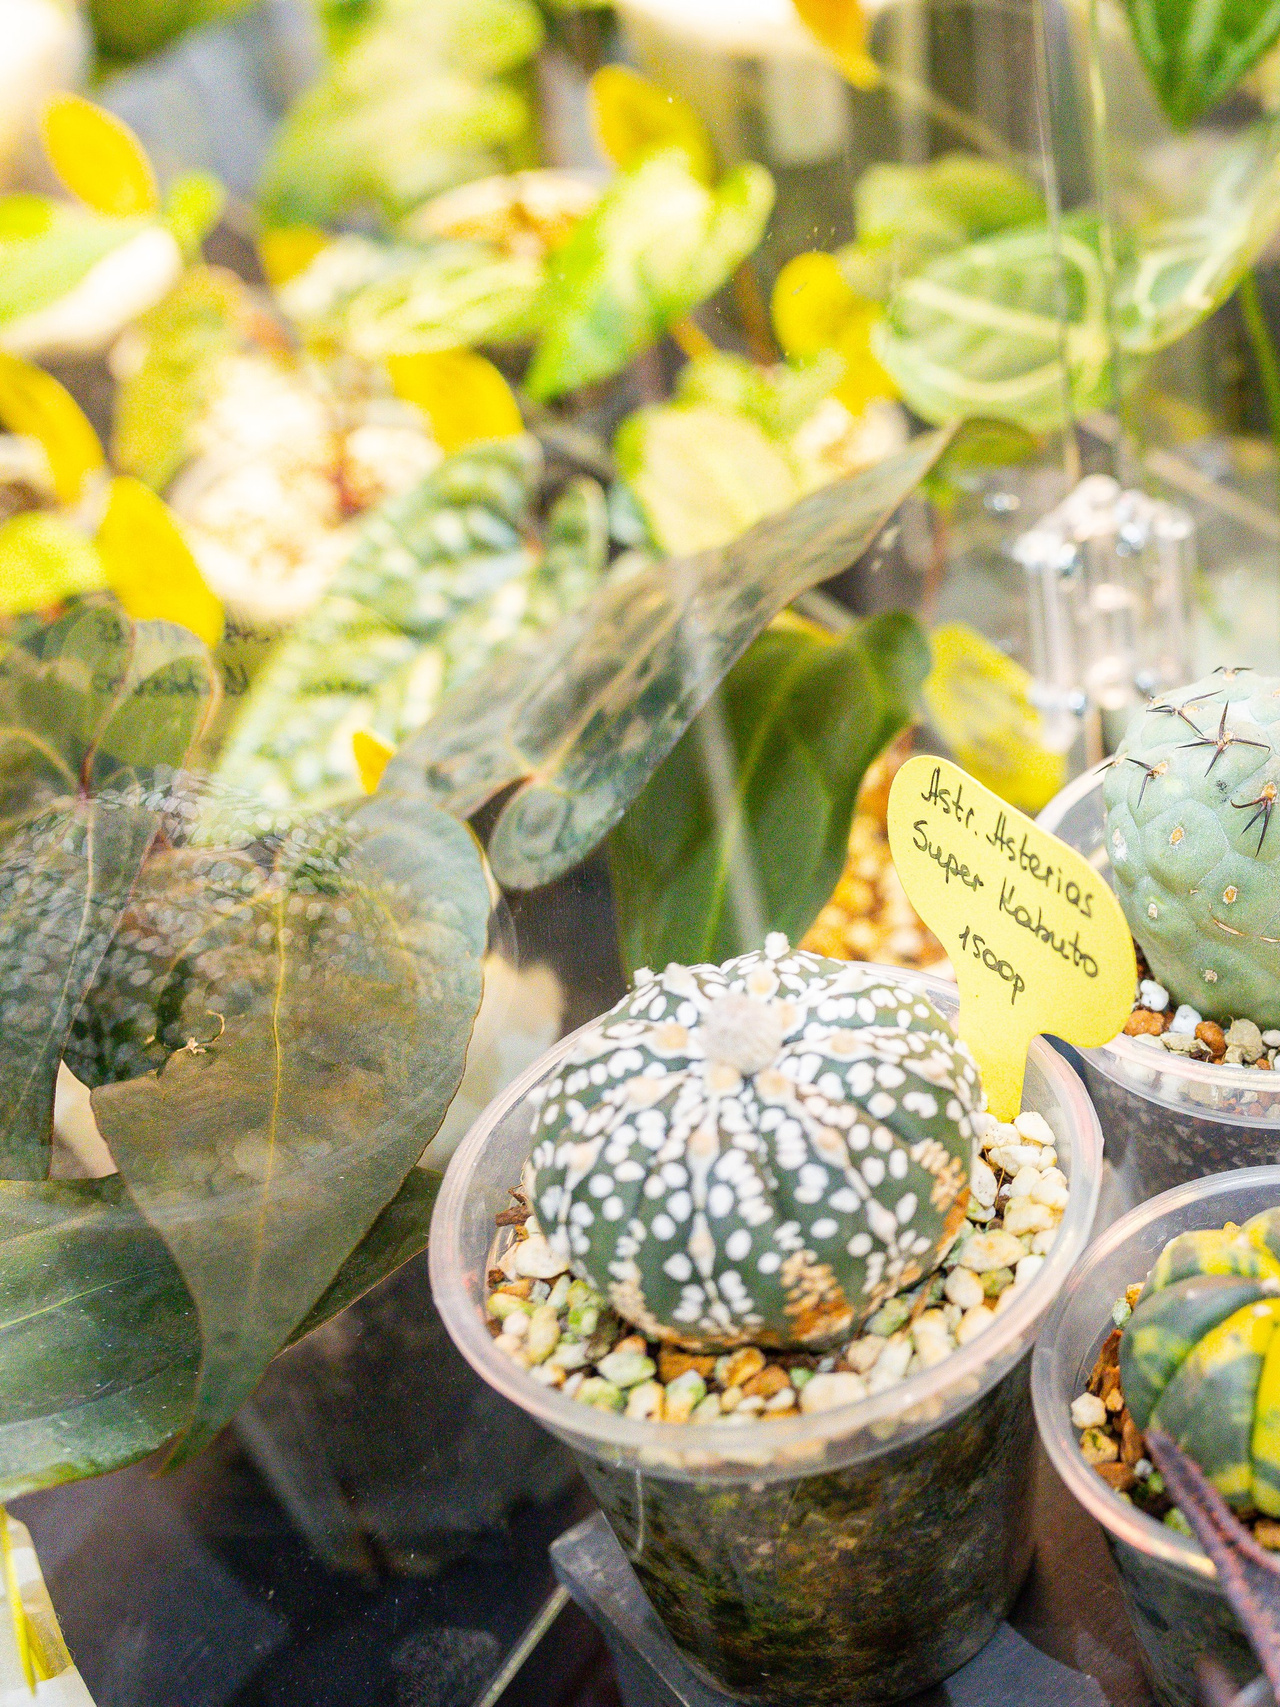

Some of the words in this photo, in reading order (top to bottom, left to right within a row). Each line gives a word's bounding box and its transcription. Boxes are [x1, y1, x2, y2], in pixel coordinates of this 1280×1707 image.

[913, 819, 985, 893] Super
[999, 877, 1099, 978] Kabuto
[986, 811, 1094, 919] Asterias
